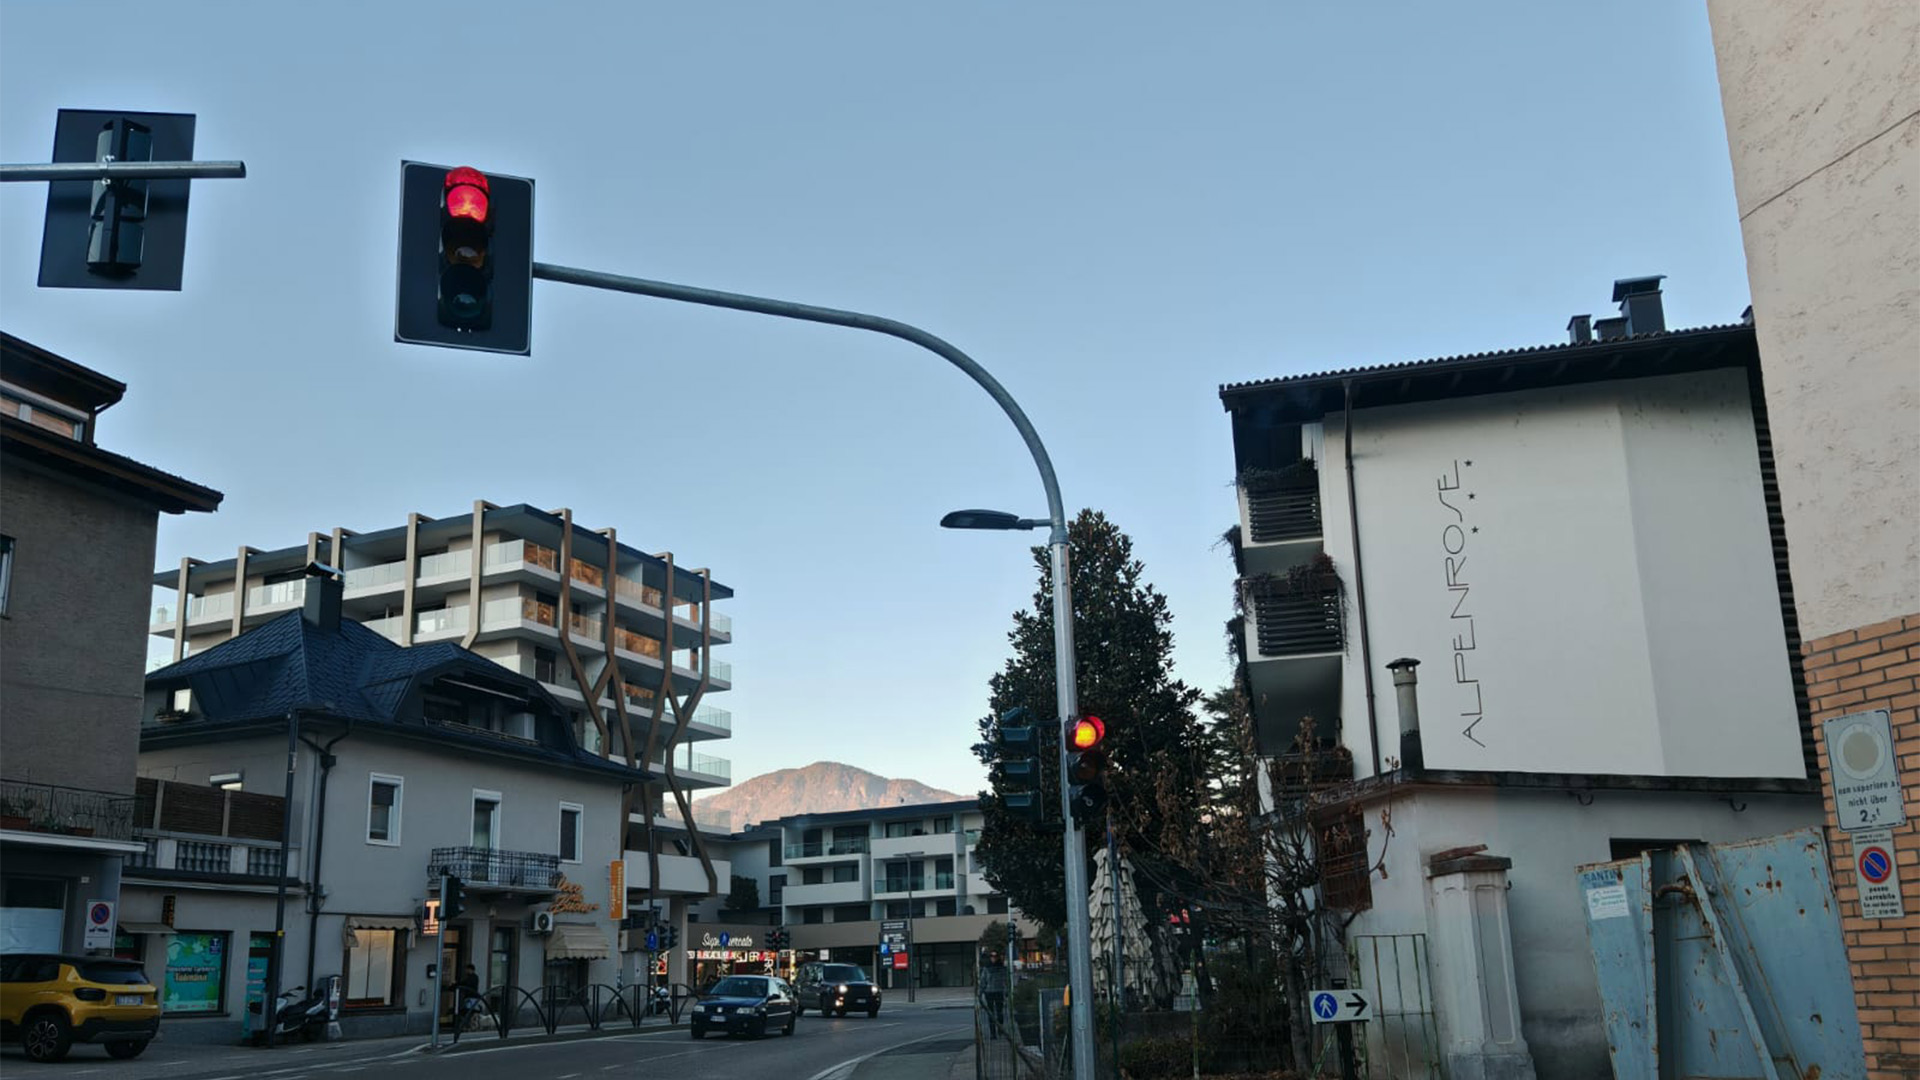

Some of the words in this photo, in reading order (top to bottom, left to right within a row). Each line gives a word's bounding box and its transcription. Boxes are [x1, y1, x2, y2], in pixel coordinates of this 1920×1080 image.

[1437, 459, 1486, 748] ALPENROSE
[1848, 796, 1868, 807] nicht
[1870, 795, 1888, 805] über
[702, 932, 753, 949] Supeercato
